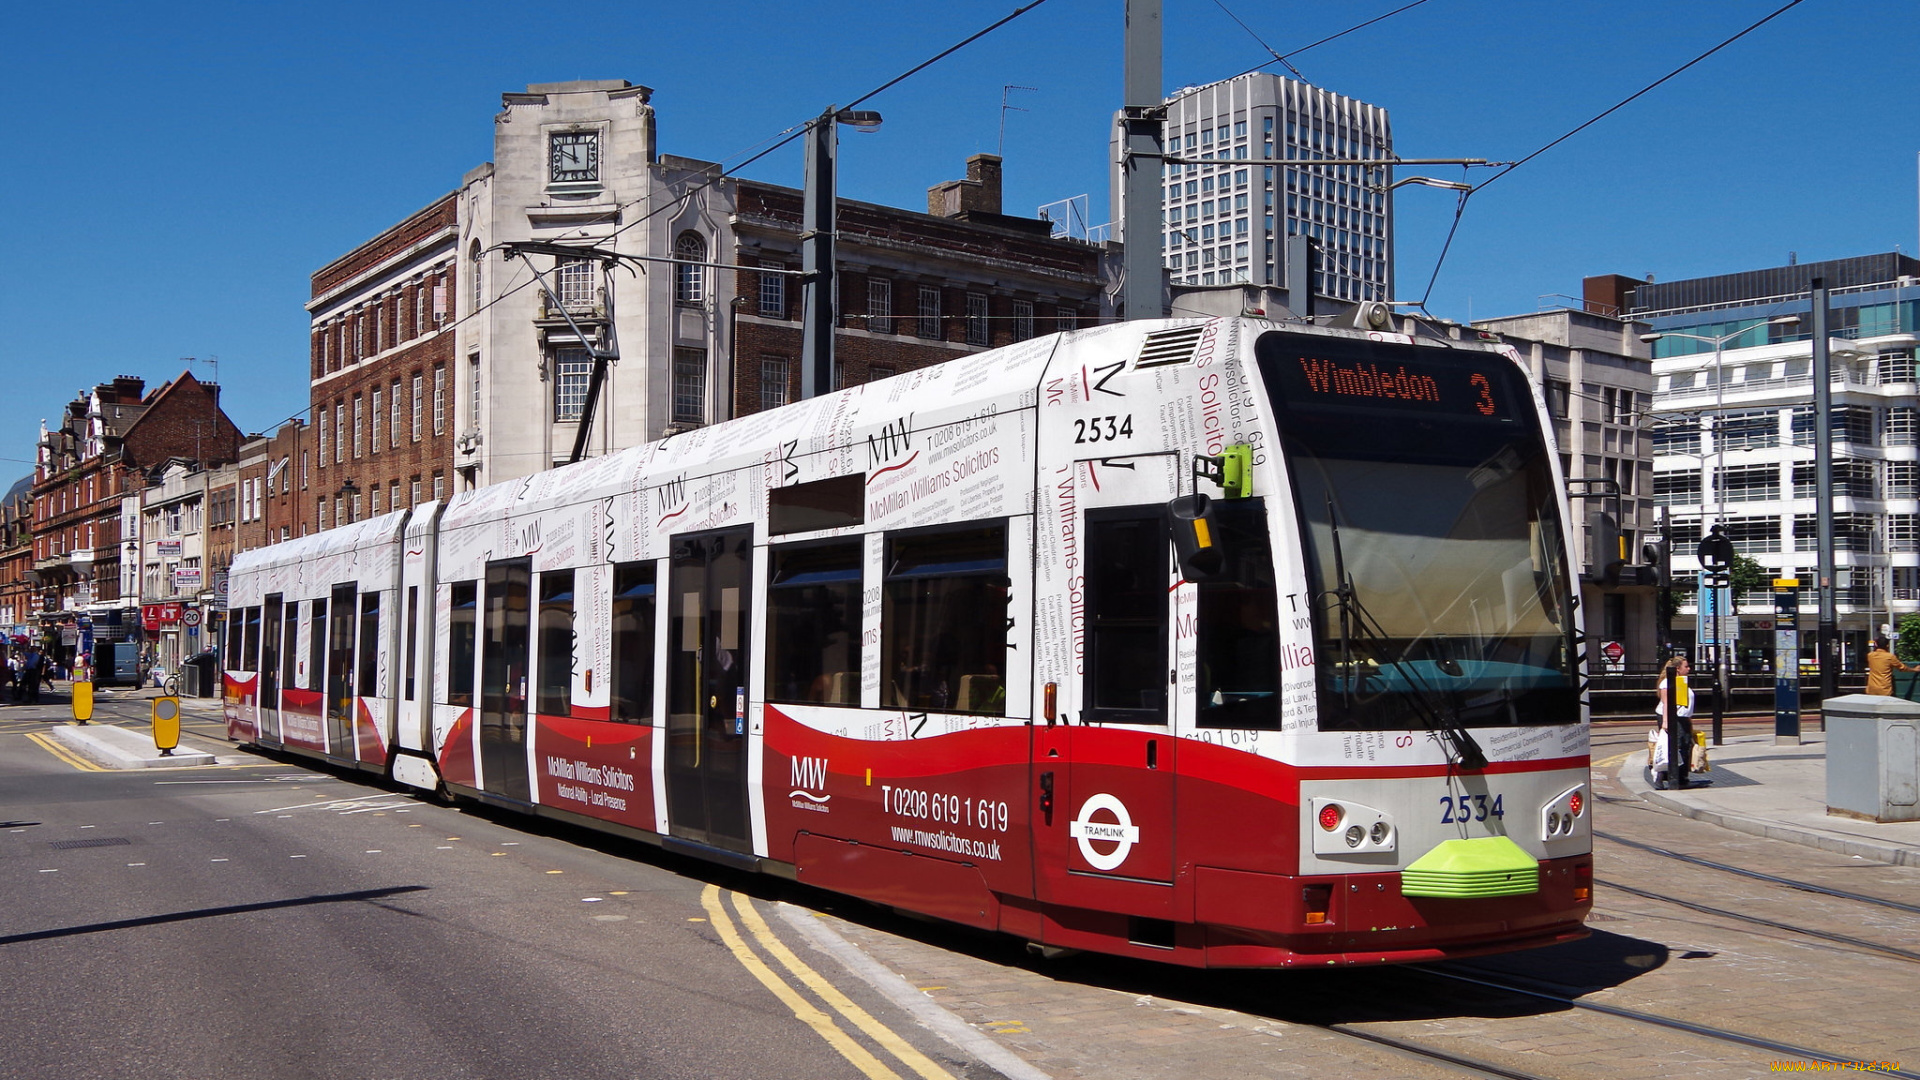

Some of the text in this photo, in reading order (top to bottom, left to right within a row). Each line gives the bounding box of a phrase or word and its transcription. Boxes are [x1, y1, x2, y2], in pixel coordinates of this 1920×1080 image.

[1299, 357, 1440, 401] Wimbledon
[1470, 373, 1495, 416] 3
[868, 411, 915, 470] MW
[927, 436, 932, 451] T
[934, 425, 954, 447] 0208
[928, 422, 998, 465] www.mwsolicitors.co.uk
[1074, 413, 1133, 444] 2534
[658, 471, 687, 516] MW
[870, 446, 999, 522] McMillan Williams Solicitors
[1057, 476, 1078, 569] Williams
[1286, 593, 1297, 613] T
[547, 755, 634, 792] McMillan Williams Solicitors
[790, 755, 828, 790] MW
[881, 785, 1008, 832] T 0208 619 1 619
[1440, 793, 1505, 824] 2534
[891, 826, 1001, 861] www.mwsolicitors.co.uk
[1084, 825, 1125, 838] TRAMLINK
